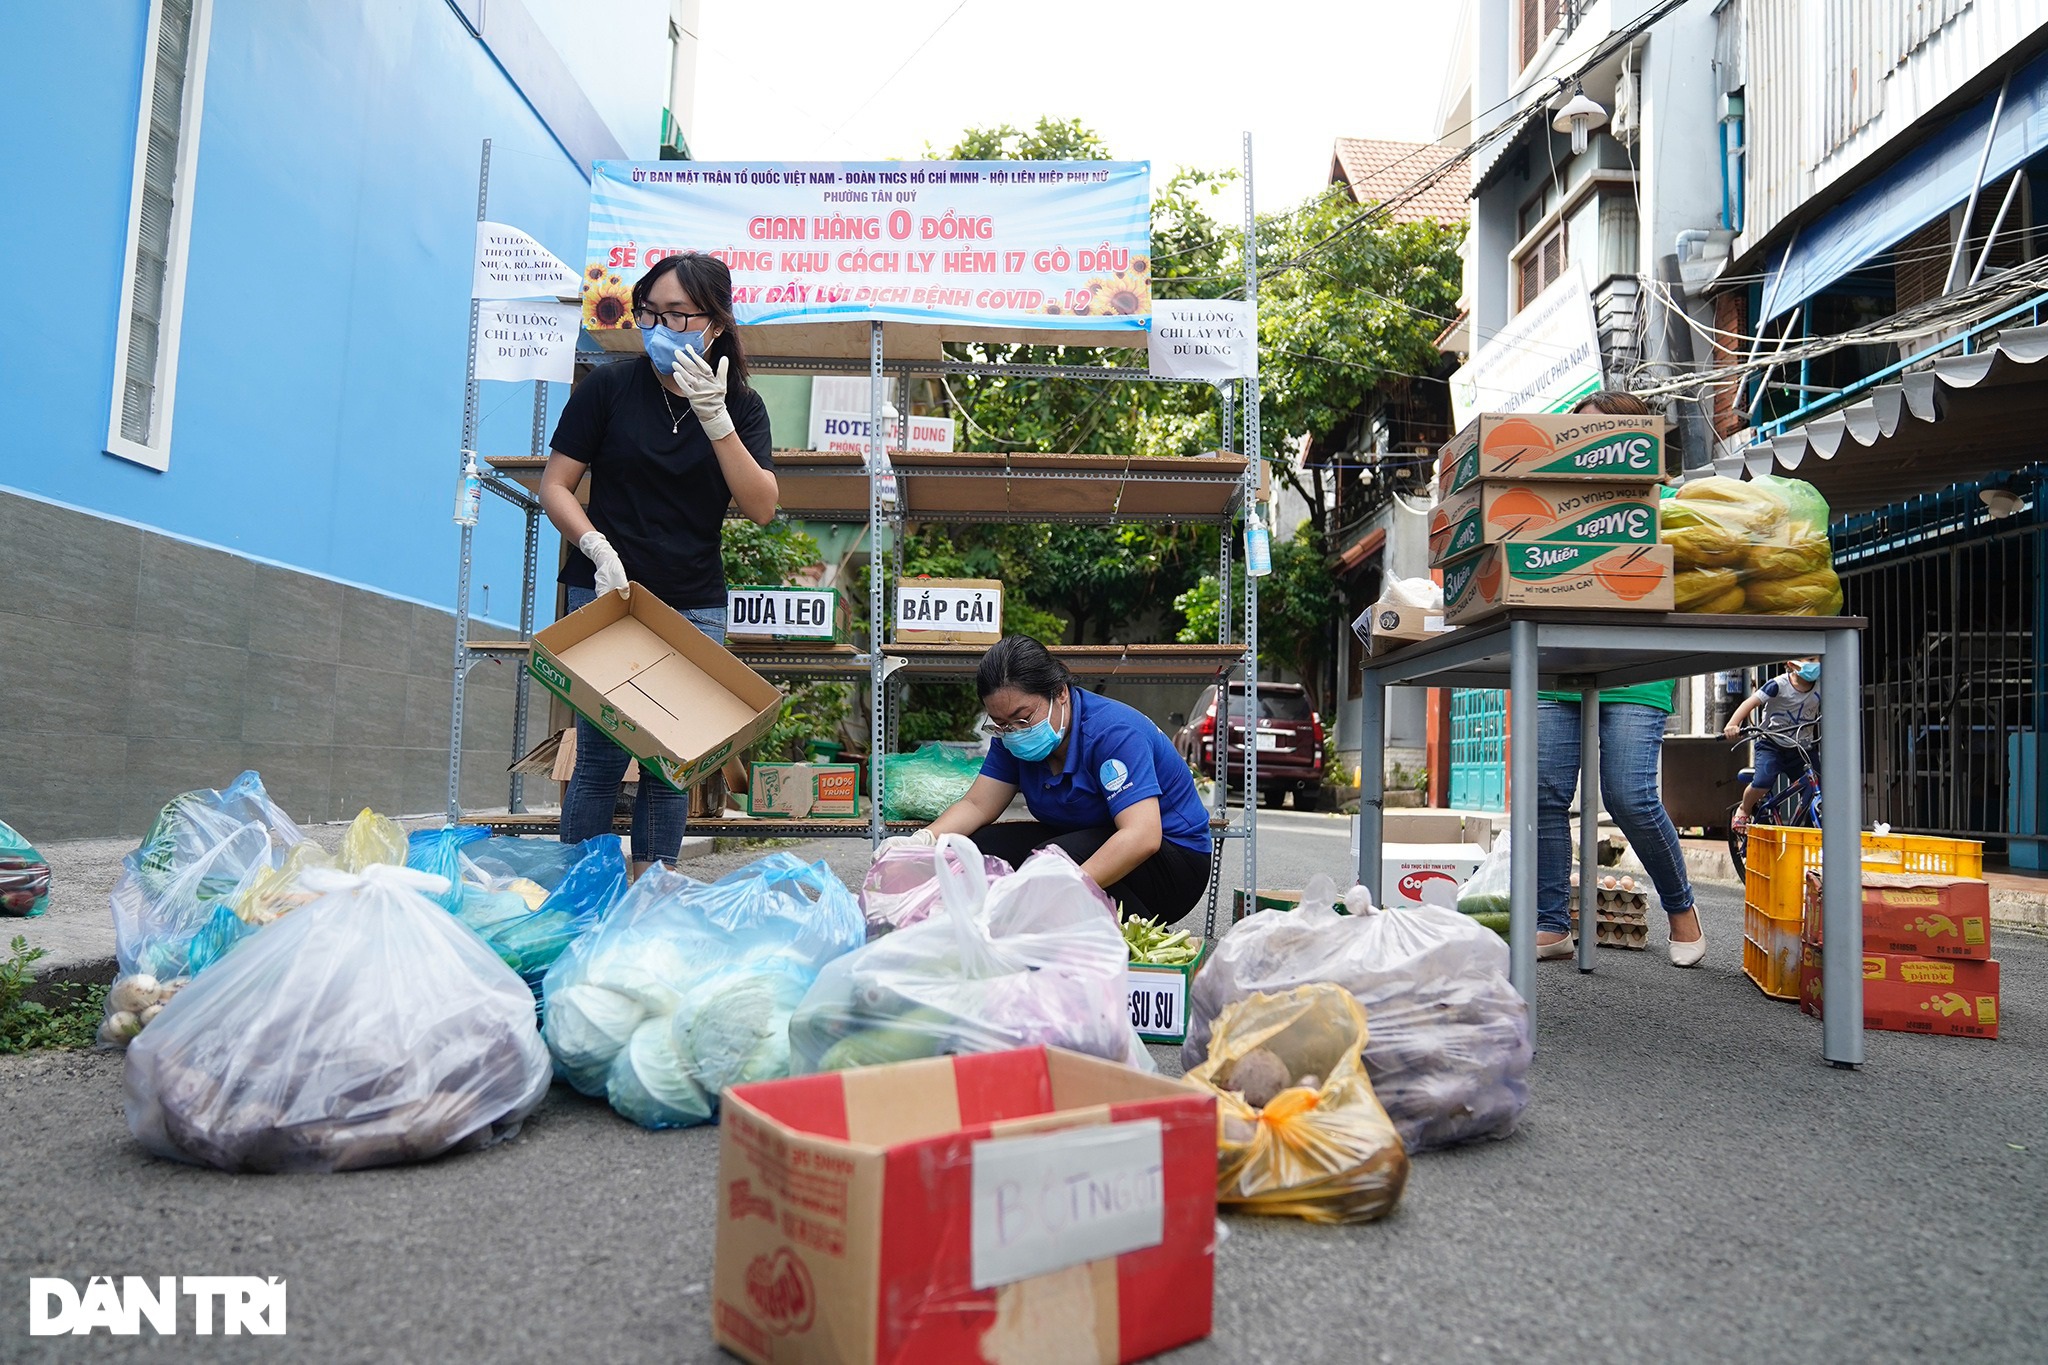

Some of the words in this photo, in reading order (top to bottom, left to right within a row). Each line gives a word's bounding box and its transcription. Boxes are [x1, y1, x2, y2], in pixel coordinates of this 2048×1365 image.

[632, 168, 647, 182] ỦY
[650, 172, 673, 182] BAN
[676, 172, 699, 186] MẶT
[703, 172, 731, 186] TRẬN
[734, 168, 748, 183] TỔ
[751, 168, 780, 184] QUỐC
[783, 170, 806, 186] VIỆT
[809, 172, 835, 184] NAM
[845, 169, 875, 184] ĐOÀN
[878, 172, 907, 183] TNCS
[910, 169, 925, 183] HỒ
[928, 169, 947, 183] CHÍ
[950, 172, 979, 183] MINH
[990, 171, 1008, 186] HỘI
[1012, 170, 1036, 183] LIÊN
[1039, 170, 1063, 185] HIỆP
[1067, 172, 1089, 185] PHỤ
[1092, 170, 1109, 183] NỮ
[823, 188, 868, 202] PHƯỜNG
[871, 188, 892, 202] TÂN
[896, 188, 917, 203] QUÝ
[748, 217, 806, 240] GIAN
[814, 212, 880, 240] HÀNG
[888, 209, 912, 240] 0
[921, 209, 993, 240] ĐỒNG
[490, 236, 507, 245] VUI
[485, 249, 512, 257] THEO
[608, 242, 637, 267] SẺ
[781, 252, 829, 272] KHU
[838, 247, 898, 272] CÁCH
[907, 252, 935, 273] LY
[944, 245, 997, 273] HẺM
[1004, 252, 1025, 273] 17
[1034, 246, 1070, 272] GÒ
[1078, 242, 1128, 272] DẦU
[765, 277, 812, 304] ĐẨY
[815, 284, 851, 304] LÙI
[854, 285, 909, 307] DỊCH
[910, 283, 973, 309] BỆNH
[976, 290, 1043, 310] COVID
[1063, 289, 1092, 310] 19
[496, 313, 518, 325] VUI
[522, 312, 558, 327] LÒNG
[1171, 312, 1193, 322] VUI
[1198, 310, 1234, 322] LÒNG
[485, 327, 509, 340] CHỈ
[539, 329, 564, 342] VỪA
[1160, 326, 1183, 338] CHỈ
[1217, 327, 1245, 339] VỪA
[498, 345, 516, 357] ĐỦ
[519, 345, 549, 358] DÙNG
[1173, 343, 1191, 355] ĐỦ
[1195, 343, 1231, 355] DÙNG
[1520, 382, 1536, 404] KHU
[1551, 355, 1570, 382] PHÍA
[1569, 342, 1590, 367] NAM
[825, 419, 876, 437] HOTE
[913, 426, 946, 442] DUNG
[1582, 420, 1615, 434] CHUA
[1618, 419, 1640, 431] TÔM
[1555, 427, 1580, 445] CAY
[1557, 497, 1582, 514] CAY
[1583, 491, 1615, 505] CHUA
[1551, 583, 1575, 594] CHUA
[1577, 579, 1594, 592] CAY
[733, 593, 777, 625] DƯA
[784, 598, 826, 626] LEO
[902, 591, 948, 621] BẮP
[955, 593, 993, 622] CẢI
[821, 776, 853, 788] 100%
[1132, 990, 1150, 1027] SU
[1155, 991, 1173, 1029] SU
